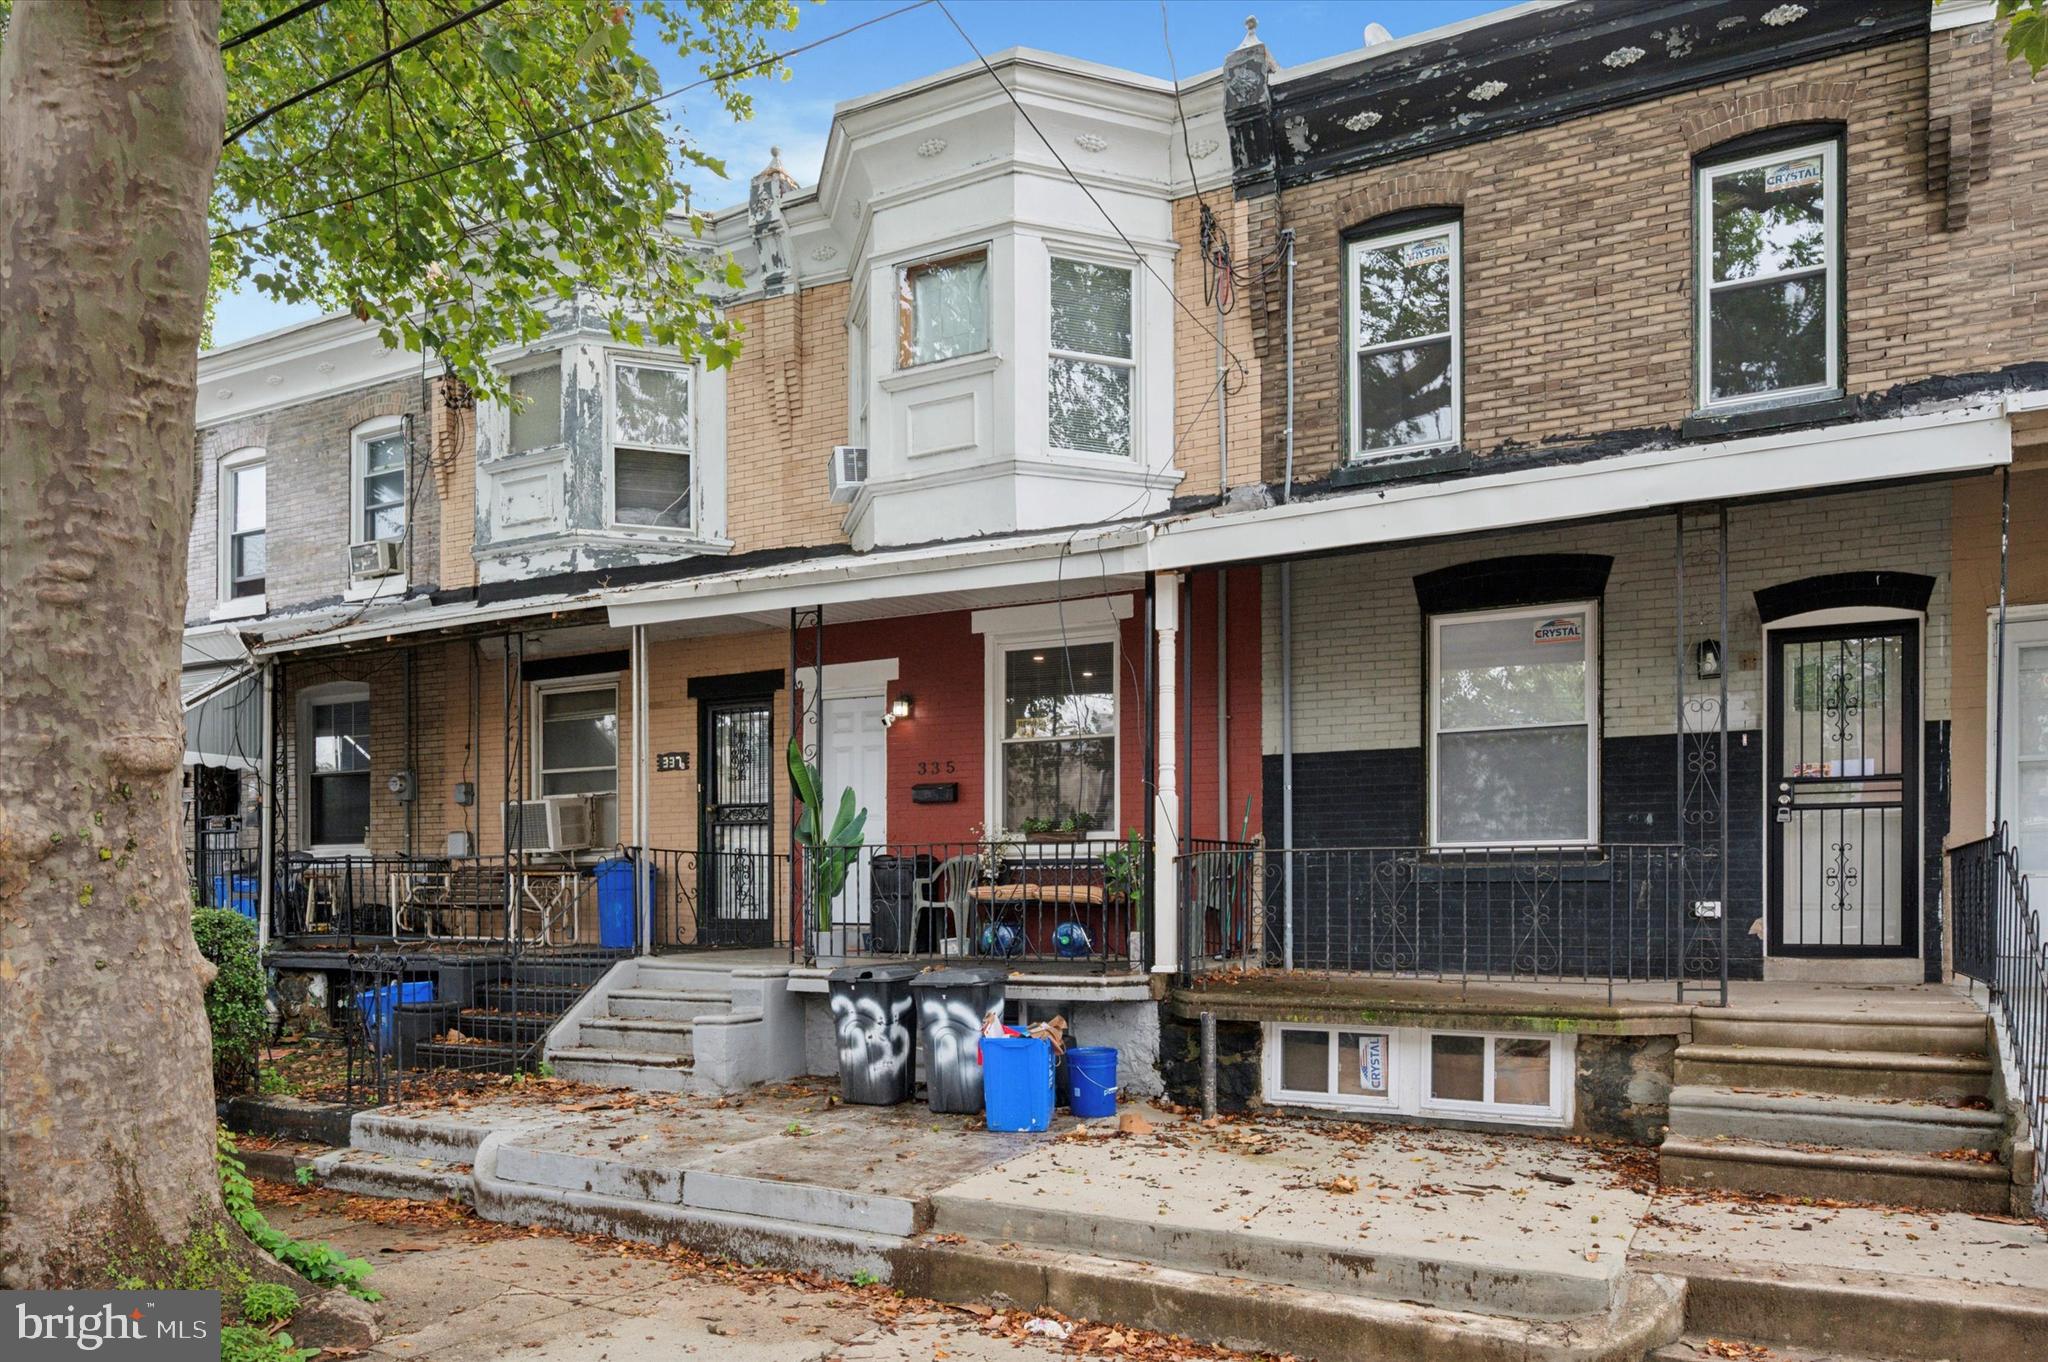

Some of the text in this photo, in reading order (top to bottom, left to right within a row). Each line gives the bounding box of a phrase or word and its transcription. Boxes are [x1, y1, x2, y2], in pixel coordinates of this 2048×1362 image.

[1767, 168, 1819, 185] CRYSTAL
[1535, 627, 1581, 638] CRYSTAL
[917, 760, 956, 776] 335
[830, 994, 913, 1082] 335
[1369, 1036, 1381, 1089] CRYSTAL
